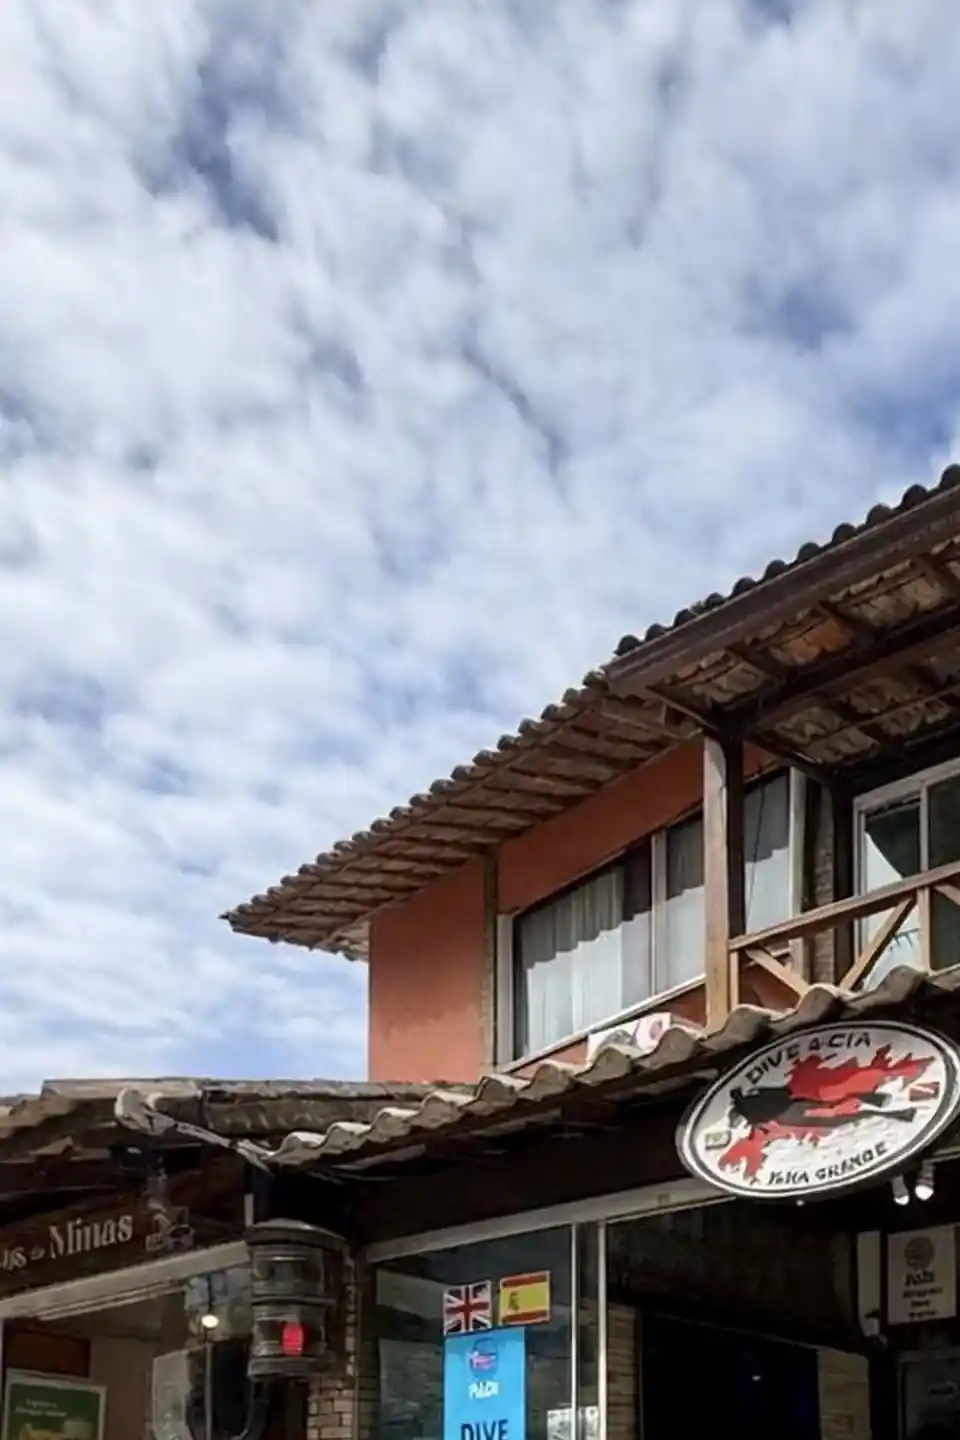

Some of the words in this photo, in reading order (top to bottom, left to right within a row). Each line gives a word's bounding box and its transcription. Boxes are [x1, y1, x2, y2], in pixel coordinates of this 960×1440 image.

[745, 1043, 800, 1084] DIVE
[827, 1032, 871, 1049] CIA
[814, 1141, 887, 1180] GRANDE
[50, 1215, 133, 1260] Minas
